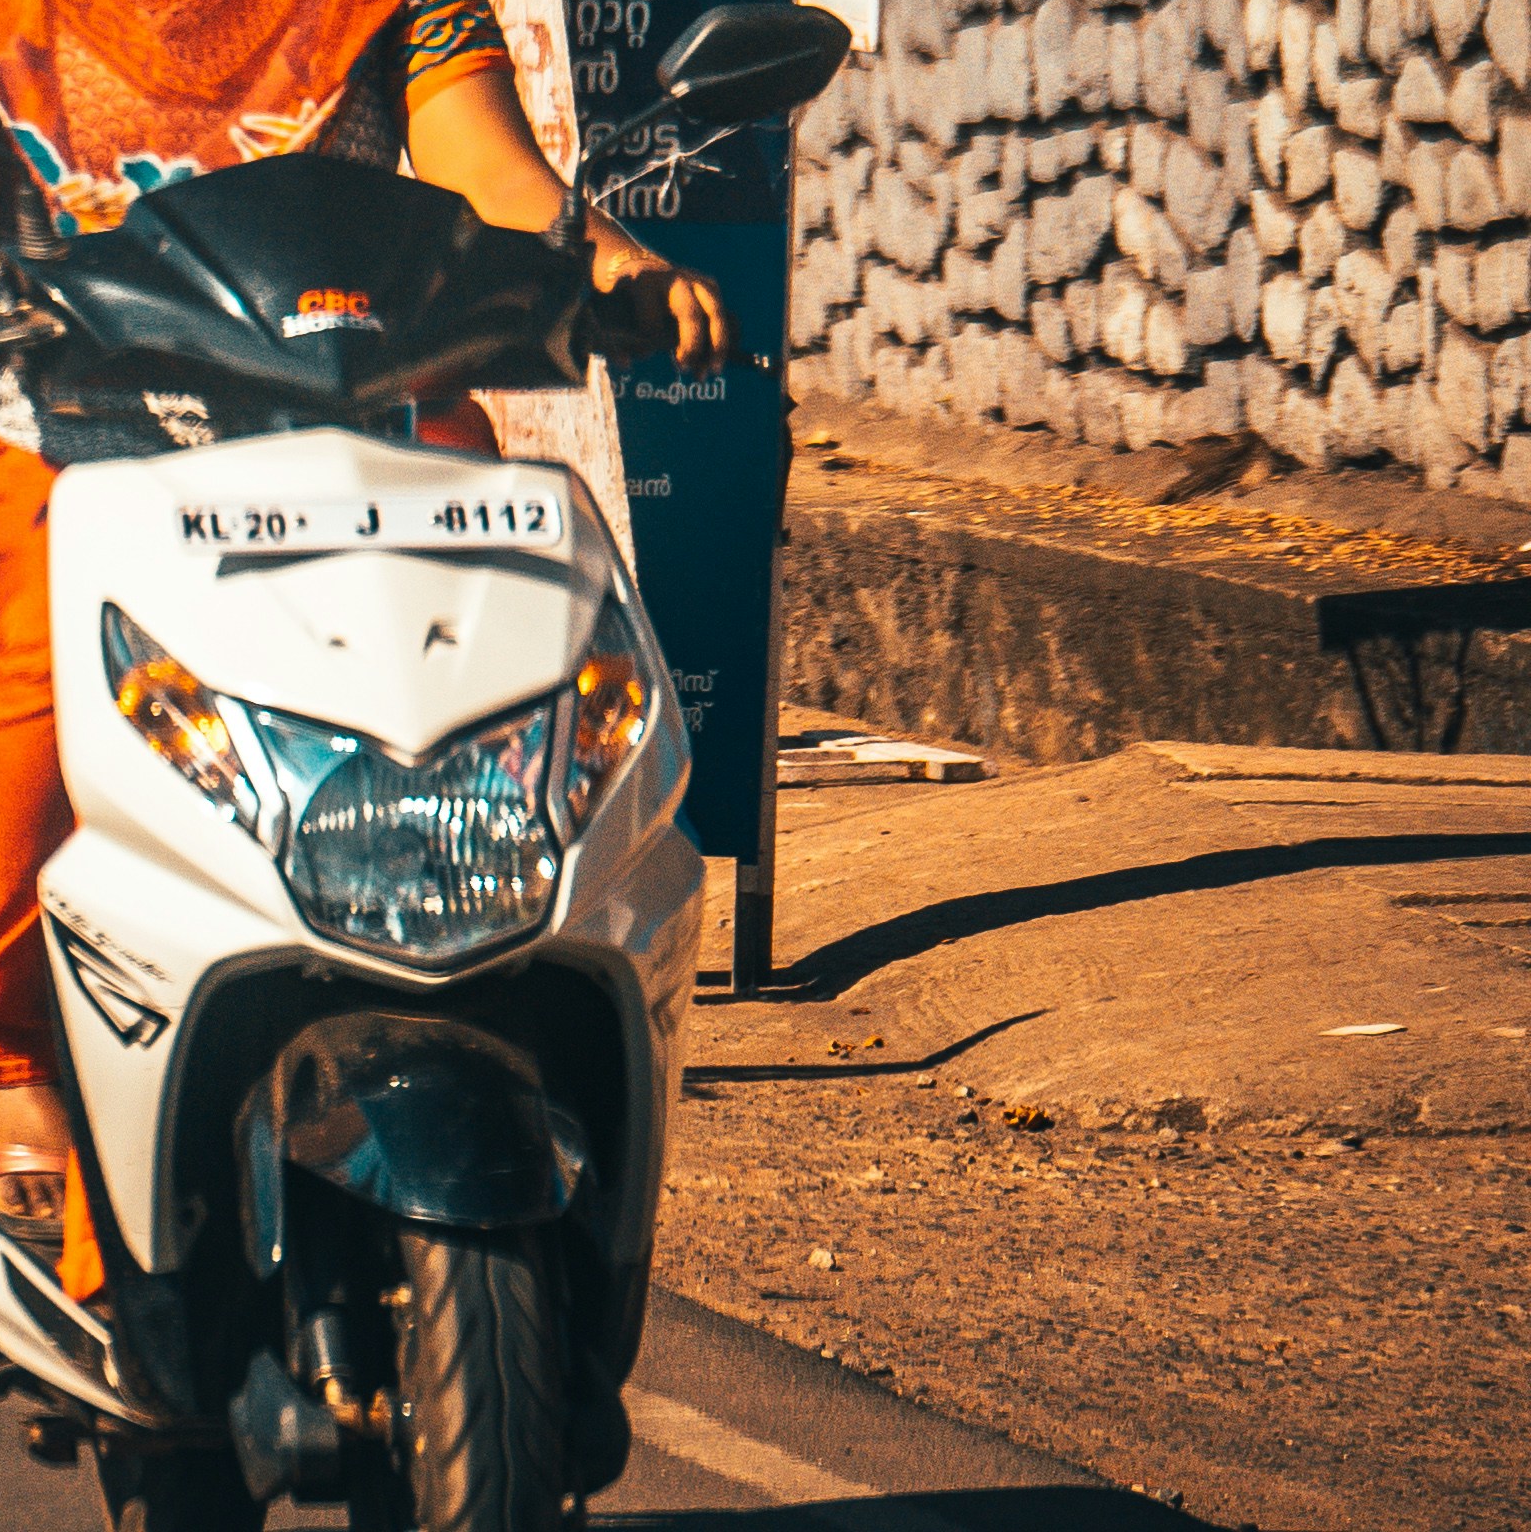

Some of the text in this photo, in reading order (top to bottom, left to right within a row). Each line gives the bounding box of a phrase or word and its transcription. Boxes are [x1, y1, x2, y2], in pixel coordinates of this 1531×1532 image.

[181, 507, 232, 541] KL
[244, 508, 287, 542] 20
[355, 500, 380, 537] J
